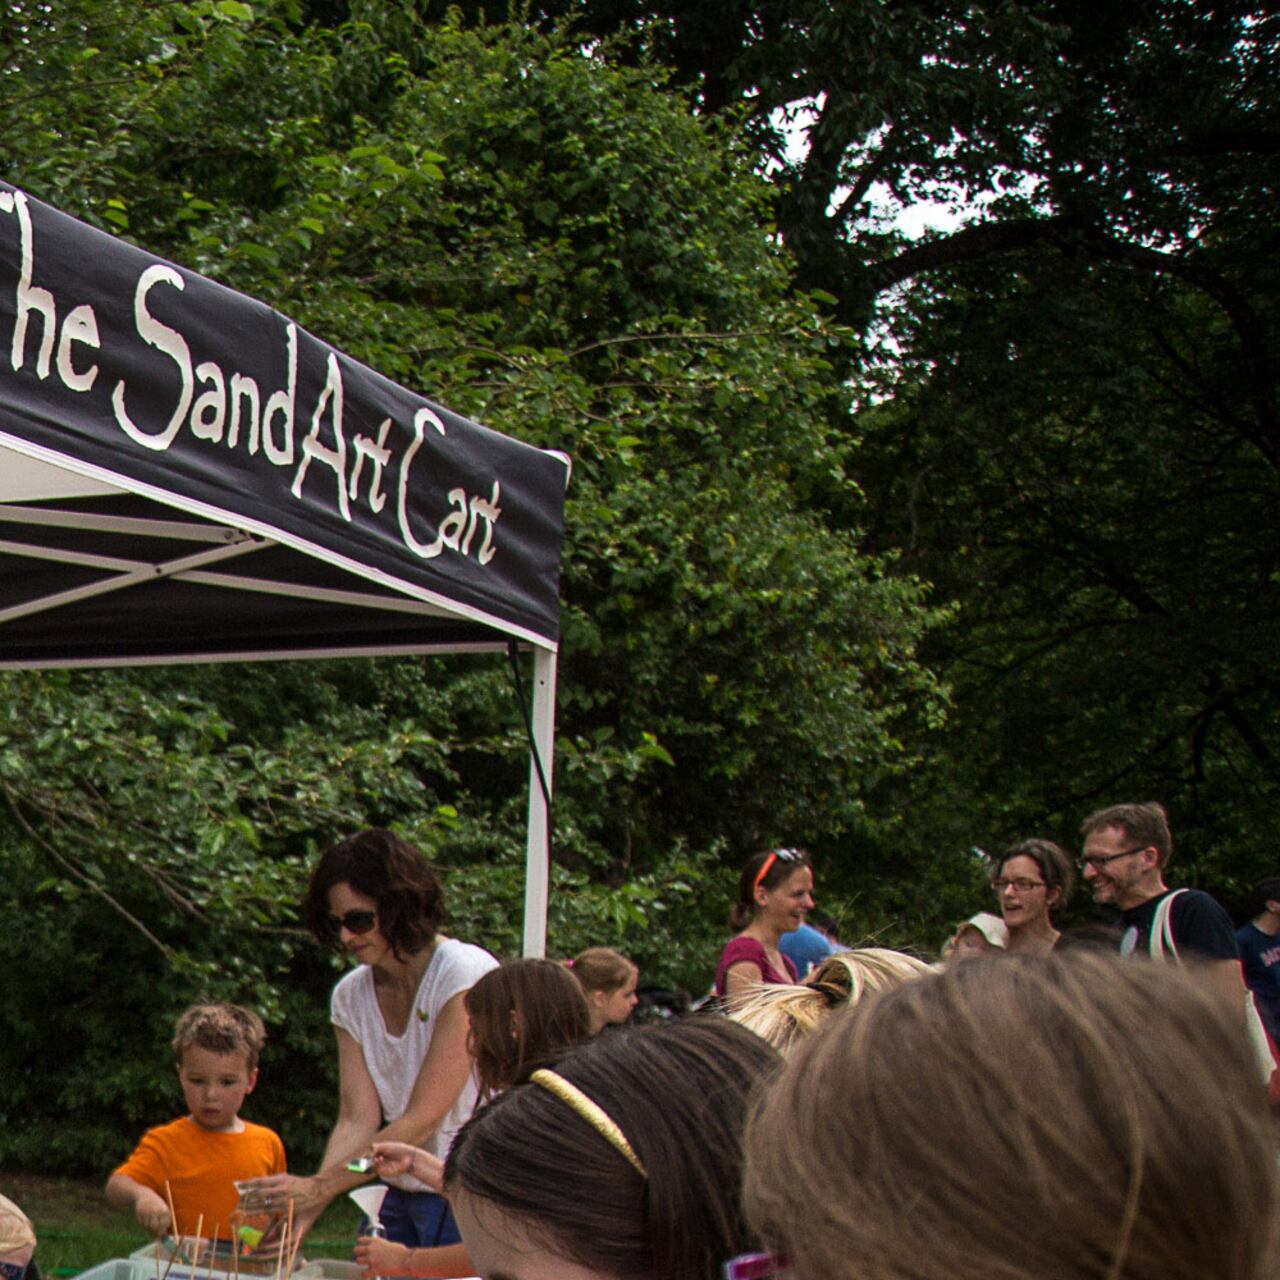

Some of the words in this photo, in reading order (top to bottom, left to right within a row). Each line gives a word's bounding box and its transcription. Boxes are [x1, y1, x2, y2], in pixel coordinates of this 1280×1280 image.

[112, 264, 297, 466] Sand
[291, 352, 393, 522] Art
[397, 407, 501, 565] Cart
